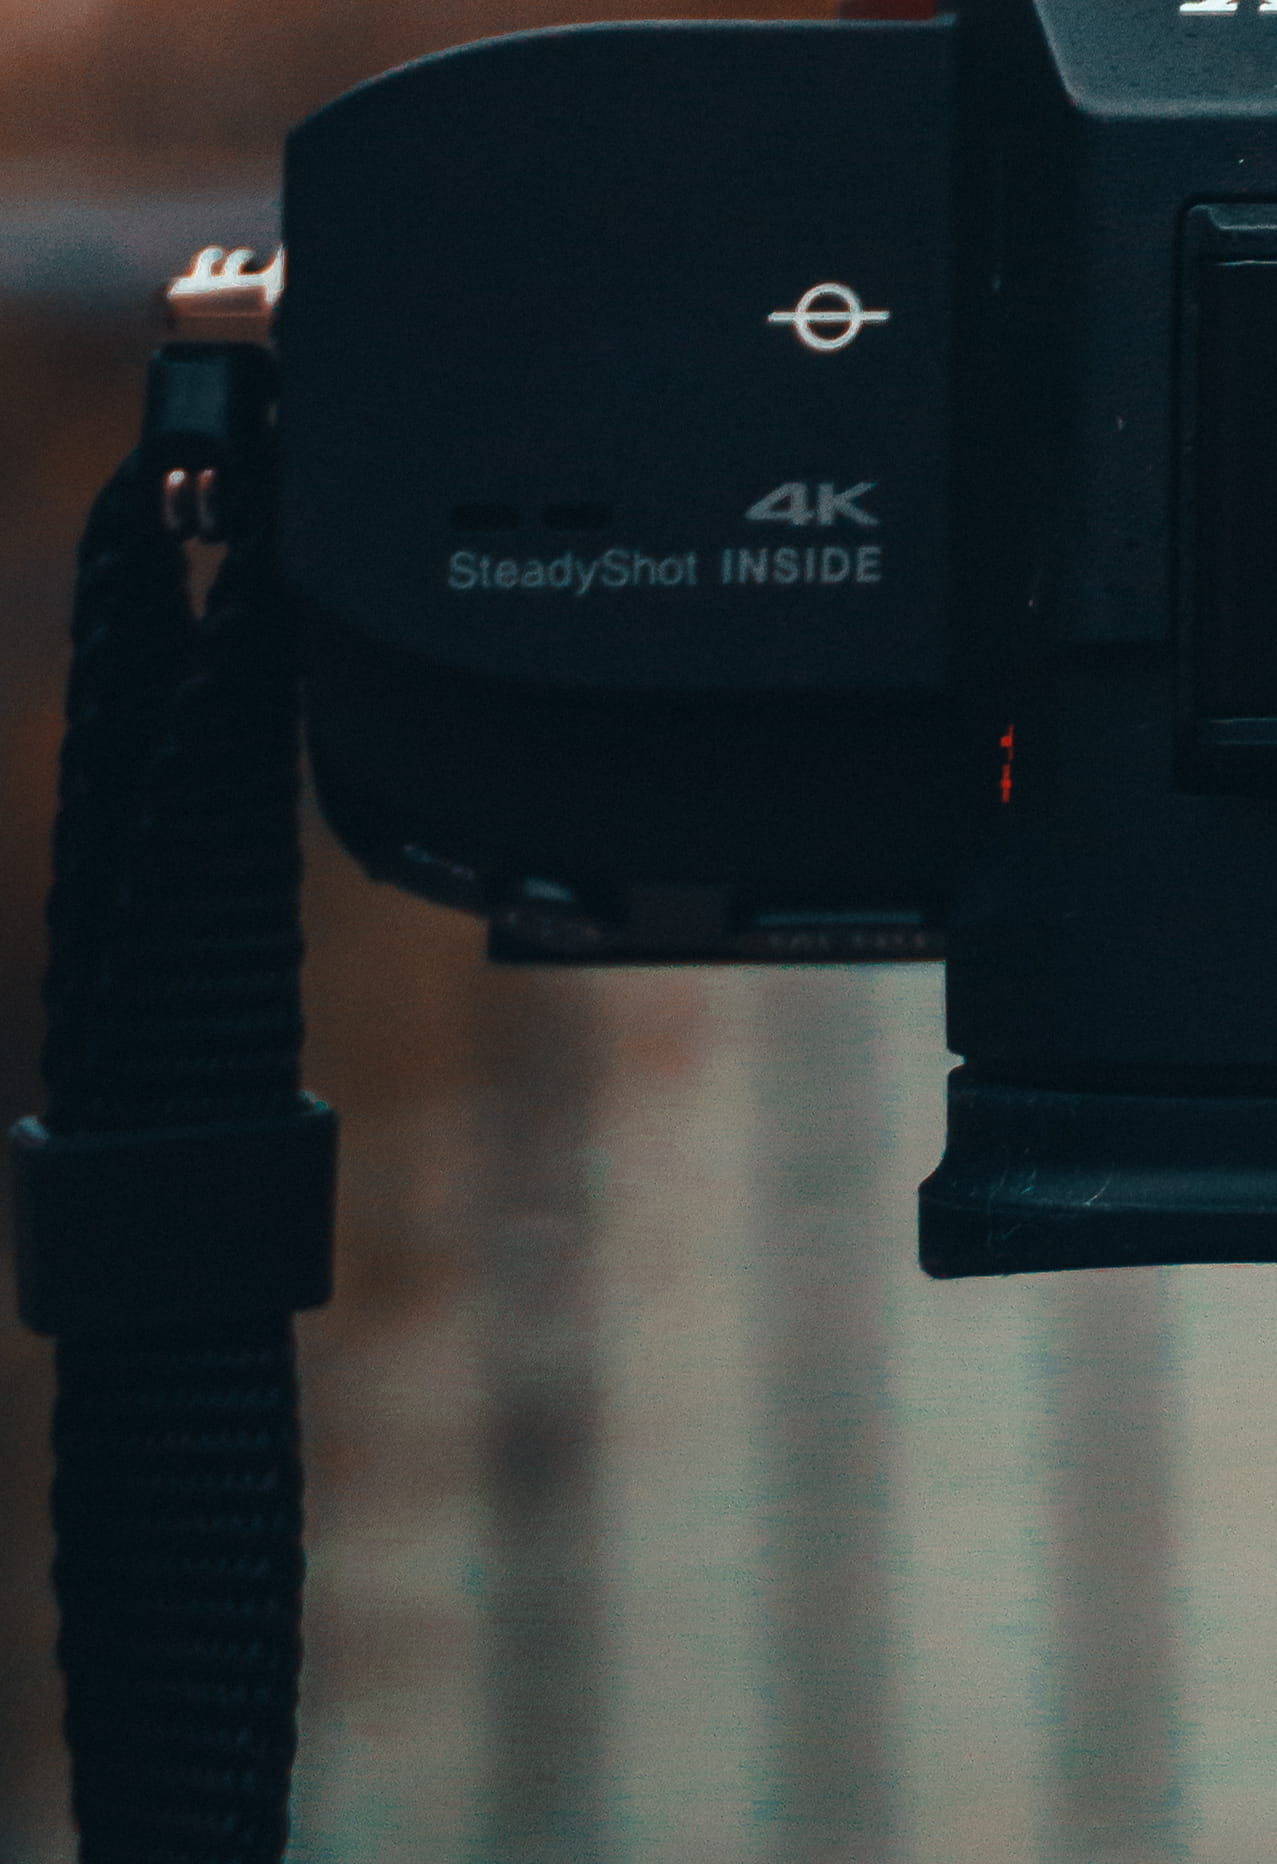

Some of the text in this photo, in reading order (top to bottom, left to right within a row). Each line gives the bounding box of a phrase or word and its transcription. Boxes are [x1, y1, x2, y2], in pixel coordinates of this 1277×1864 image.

[745, 480, 878, 527] 4K
[446, 543, 882, 596] SteadyShot INSIDE
